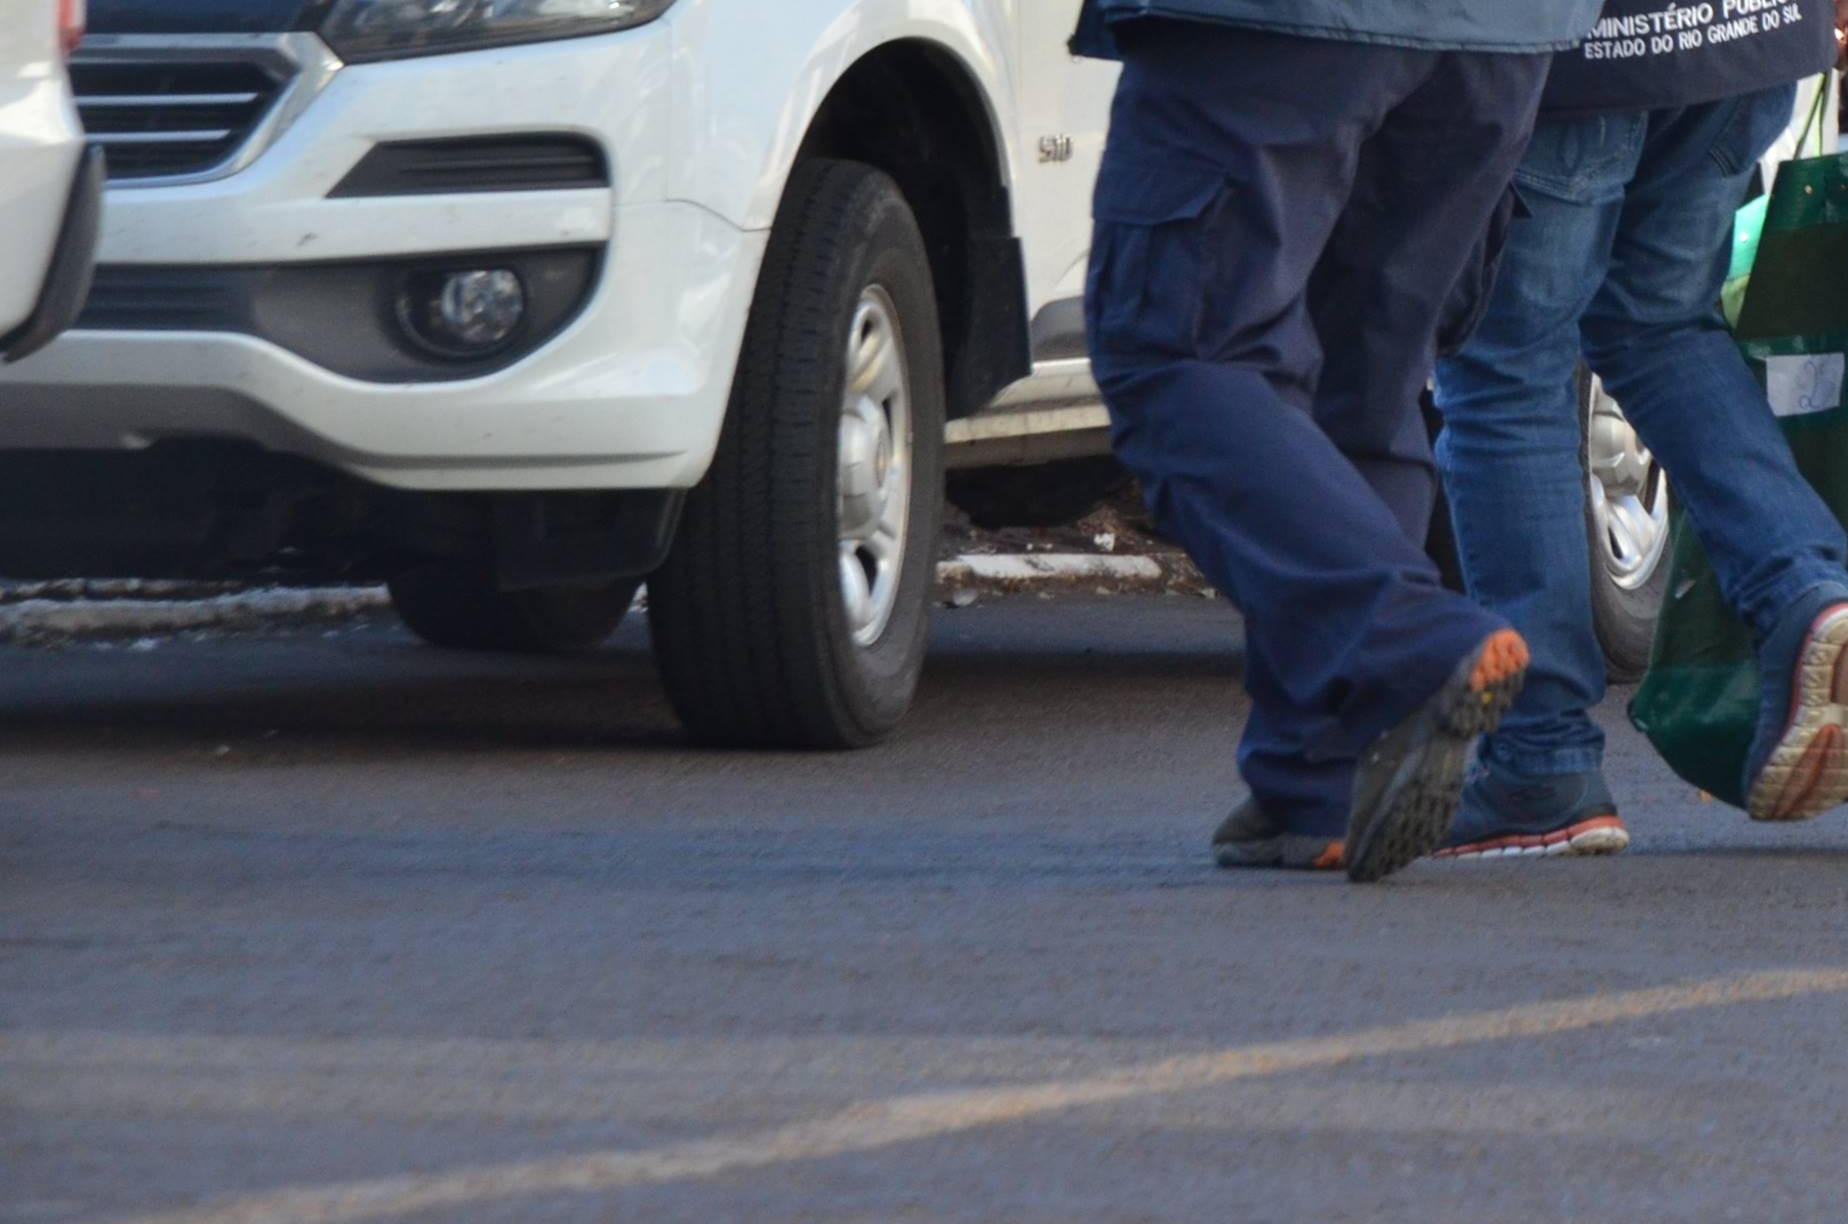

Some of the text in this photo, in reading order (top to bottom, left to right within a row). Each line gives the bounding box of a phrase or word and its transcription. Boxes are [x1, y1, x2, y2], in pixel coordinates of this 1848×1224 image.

[1584, 4, 1802, 60] ESTADO DO RIO GRANDE DO SUL
[1587, 3, 1714, 39] MINISTÉRIO
